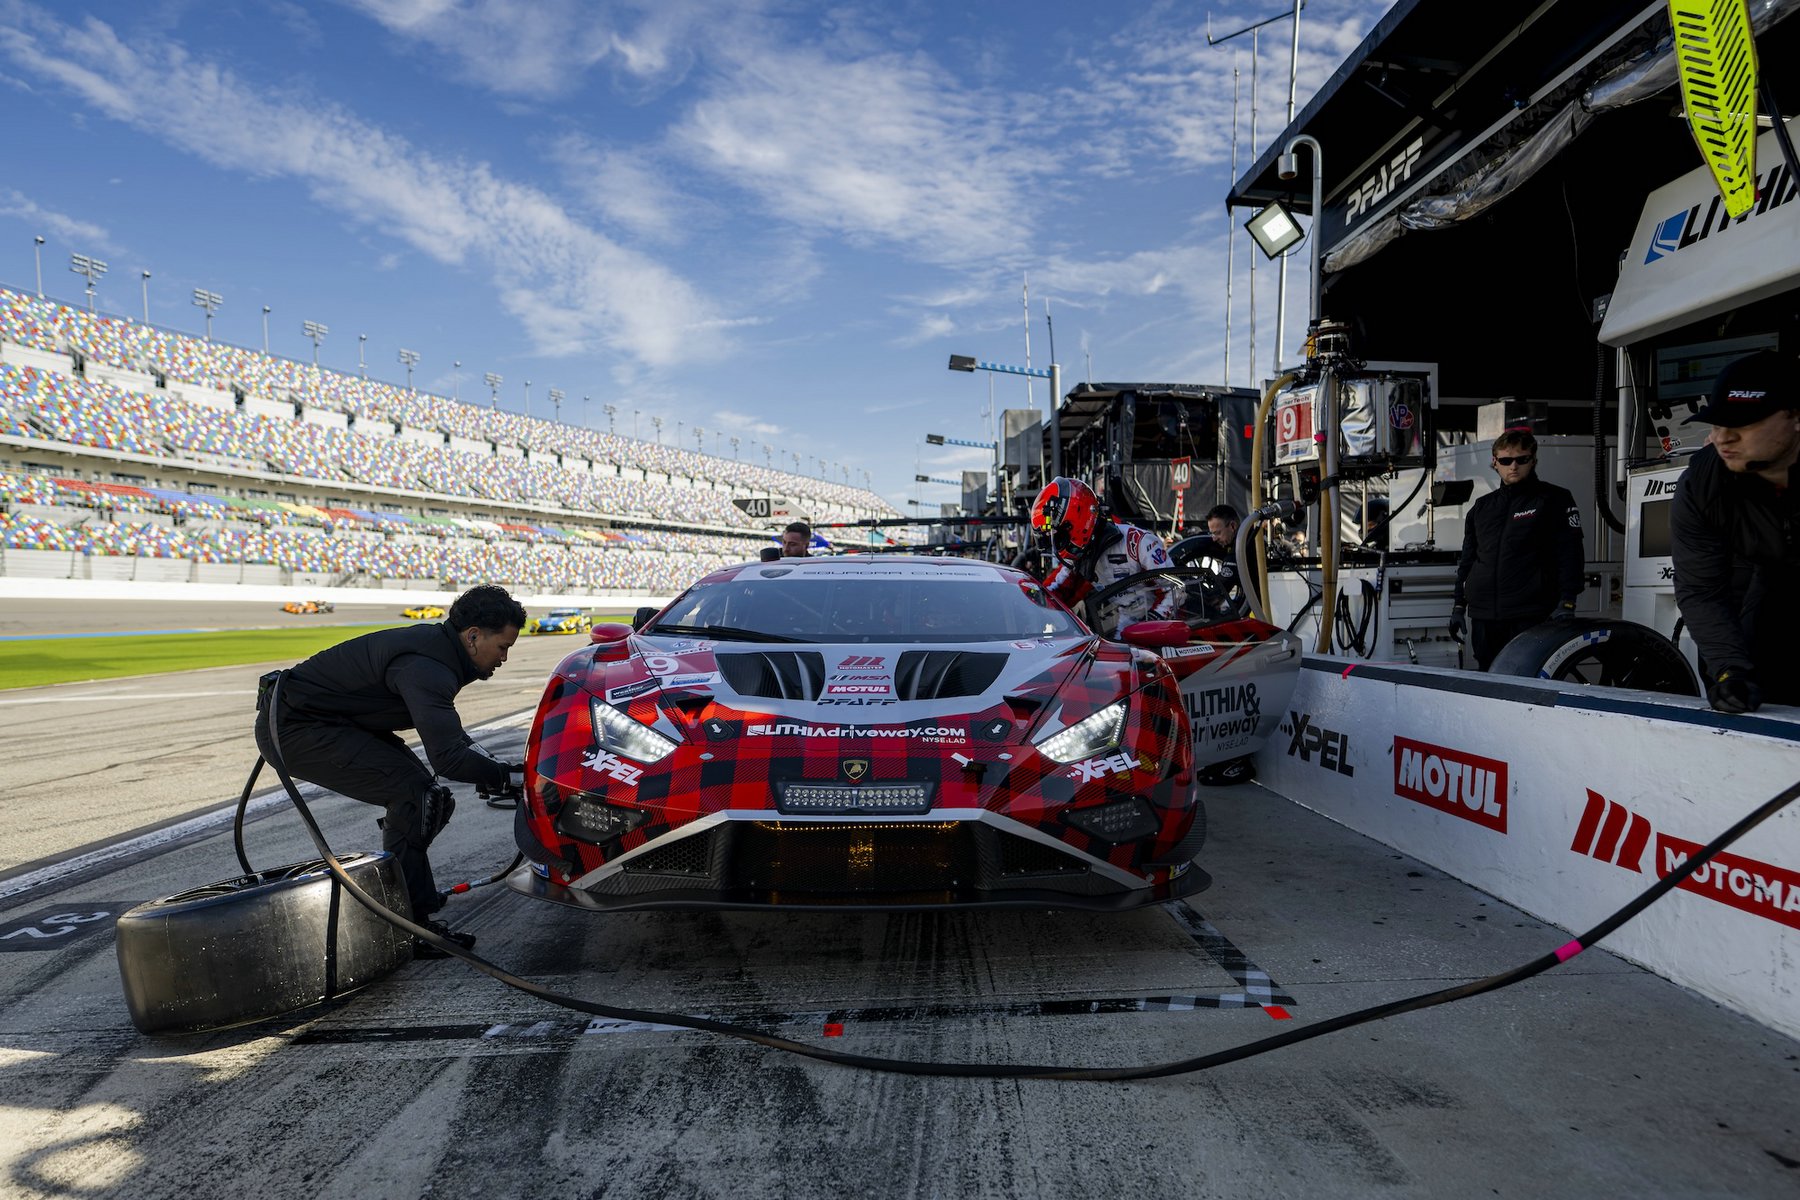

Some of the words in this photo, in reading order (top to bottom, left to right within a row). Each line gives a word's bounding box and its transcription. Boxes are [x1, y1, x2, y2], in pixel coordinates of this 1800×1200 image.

[1345, 136, 1423, 226] PFAFF
[1283, 407, 1297, 440] 9
[1174, 463, 1188, 483] 40
[746, 499, 768, 517] 40
[643, 656, 680, 676] 9
[817, 698, 898, 706] PFAFF
[1287, 710, 1354, 778] XPEL
[580, 748, 644, 787] XPEL
[1071, 752, 1141, 784] XPEL
[1398, 747, 1502, 818] MOTUL
